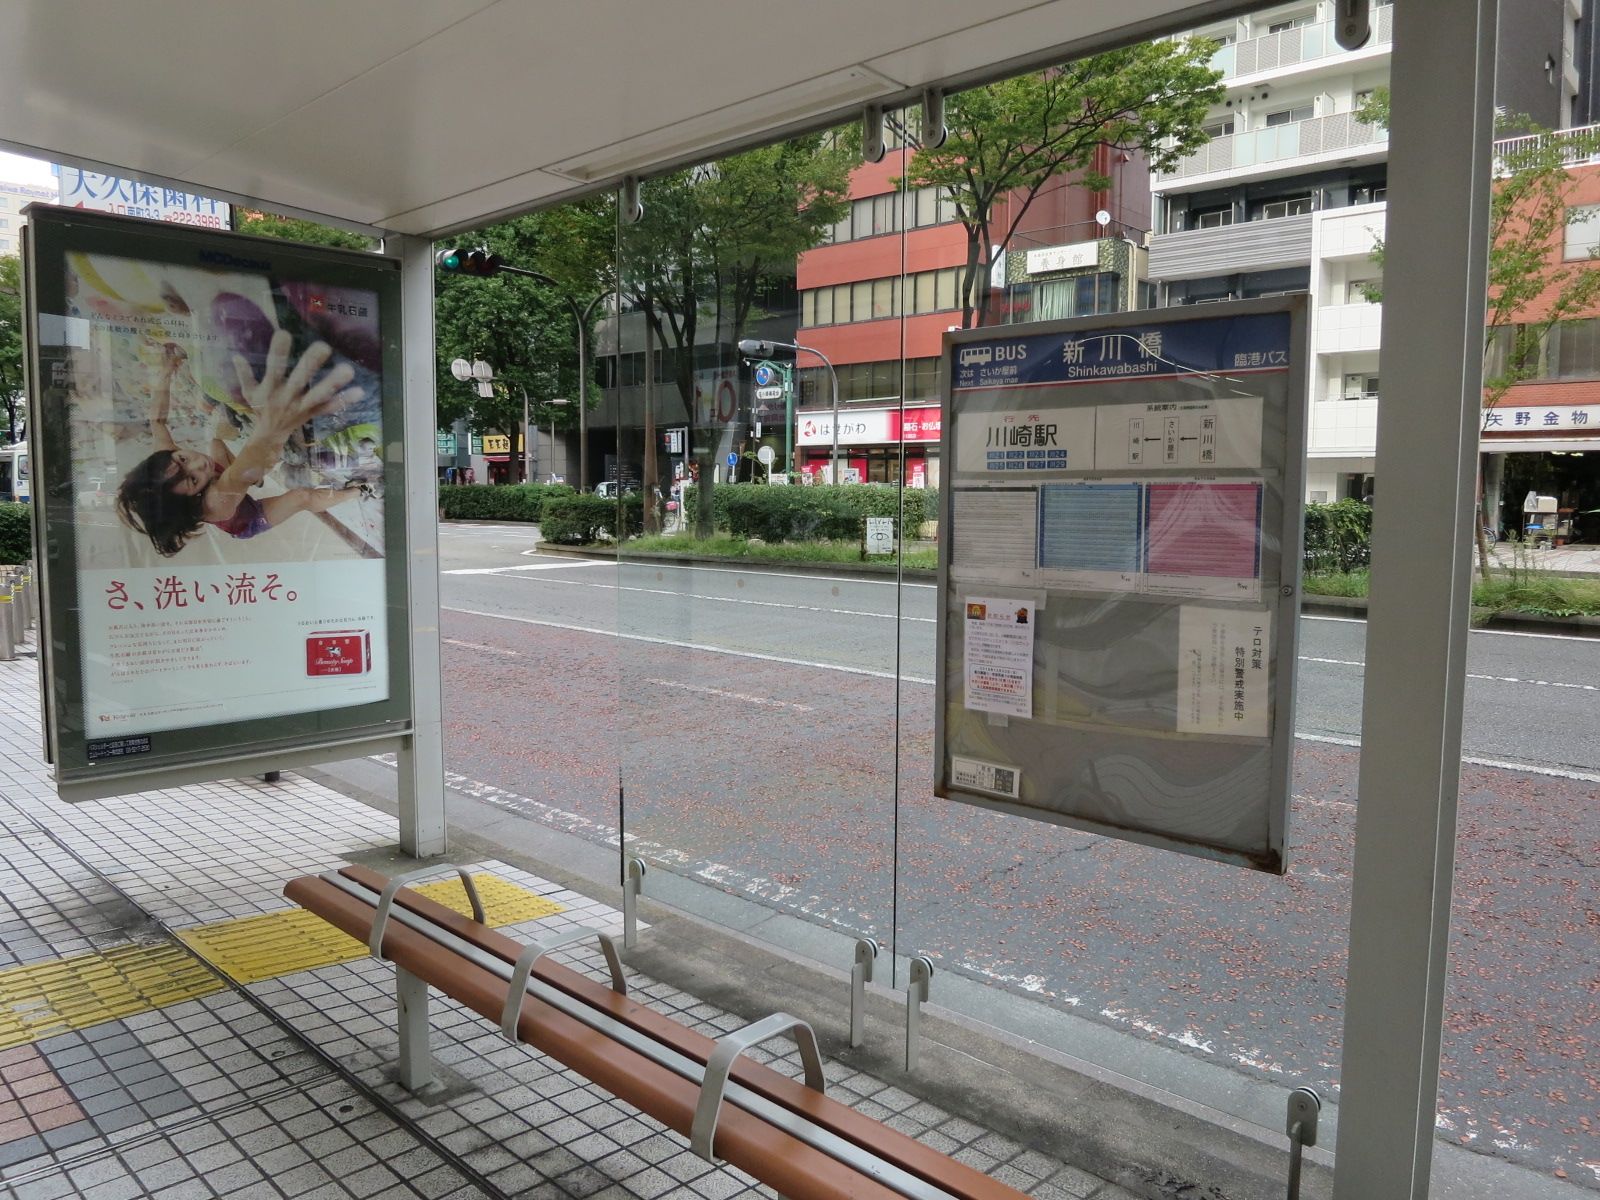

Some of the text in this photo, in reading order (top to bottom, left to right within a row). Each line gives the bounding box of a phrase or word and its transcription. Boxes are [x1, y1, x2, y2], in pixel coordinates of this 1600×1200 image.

[995, 344, 1027, 361] BUS
[1063, 331, 1162, 365] 新川橋
[1234, 351, 1288, 368] 臨港バス
[1067, 362, 1158, 378] Shinkawabashi
[986, 424, 1058, 448] 川崎駅
[1202, 419, 1214, 461] 新川橋
[105, 572, 298, 611] さ、洗い流そ。
[1251, 626, 1263, 670] テロ対策
[1233, 646, 1246, 721] 特別警戒実施中
